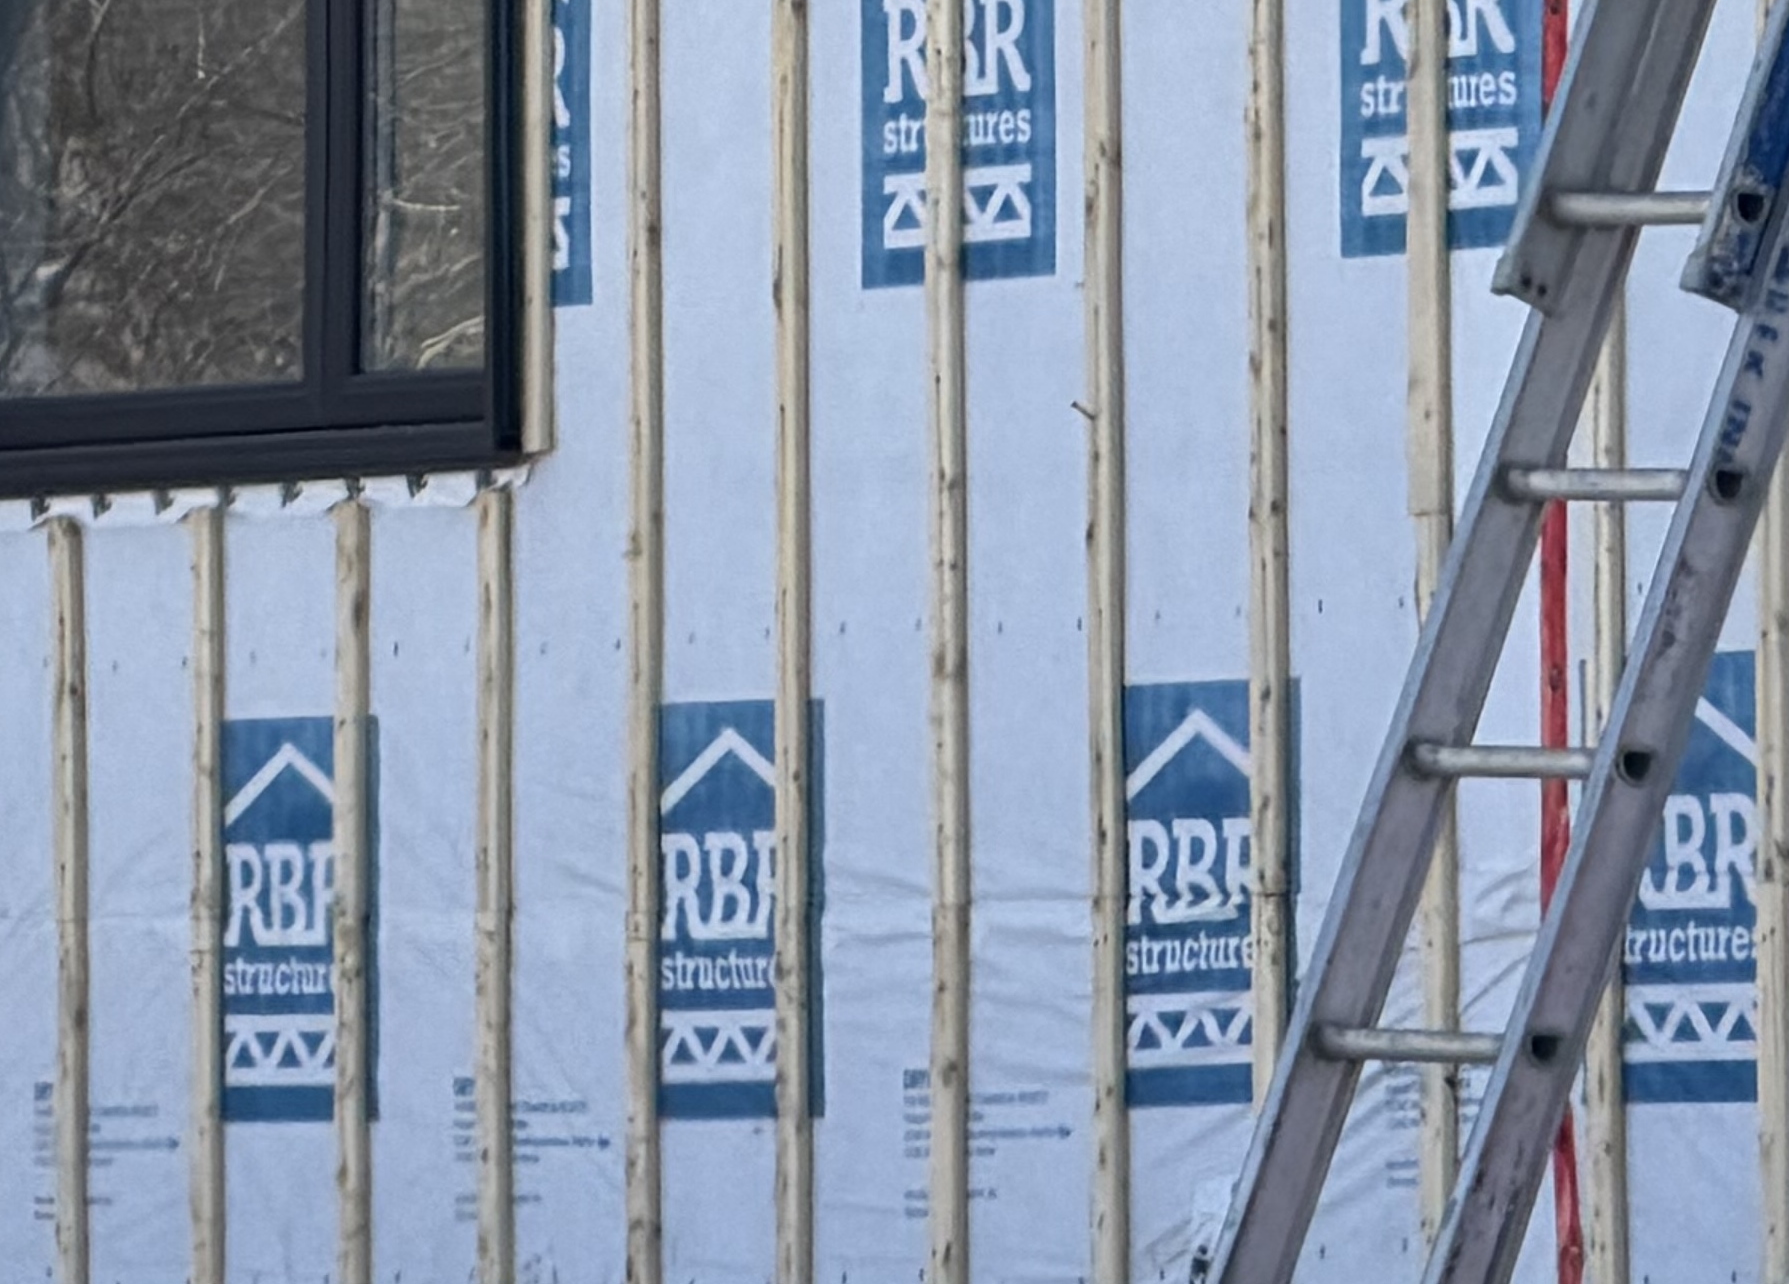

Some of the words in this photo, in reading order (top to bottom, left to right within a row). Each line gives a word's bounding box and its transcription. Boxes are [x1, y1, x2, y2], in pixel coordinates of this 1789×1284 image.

[1360, 69, 1517, 117] strures
[882, 109, 1032, 154] strures
[1638, 793, 1758, 911] BR
[1126, 930, 1255, 974] structure
[1625, 921, 1758, 965] ructure
[223, 956, 335, 995] structur
[661, 948, 778, 991] structur
